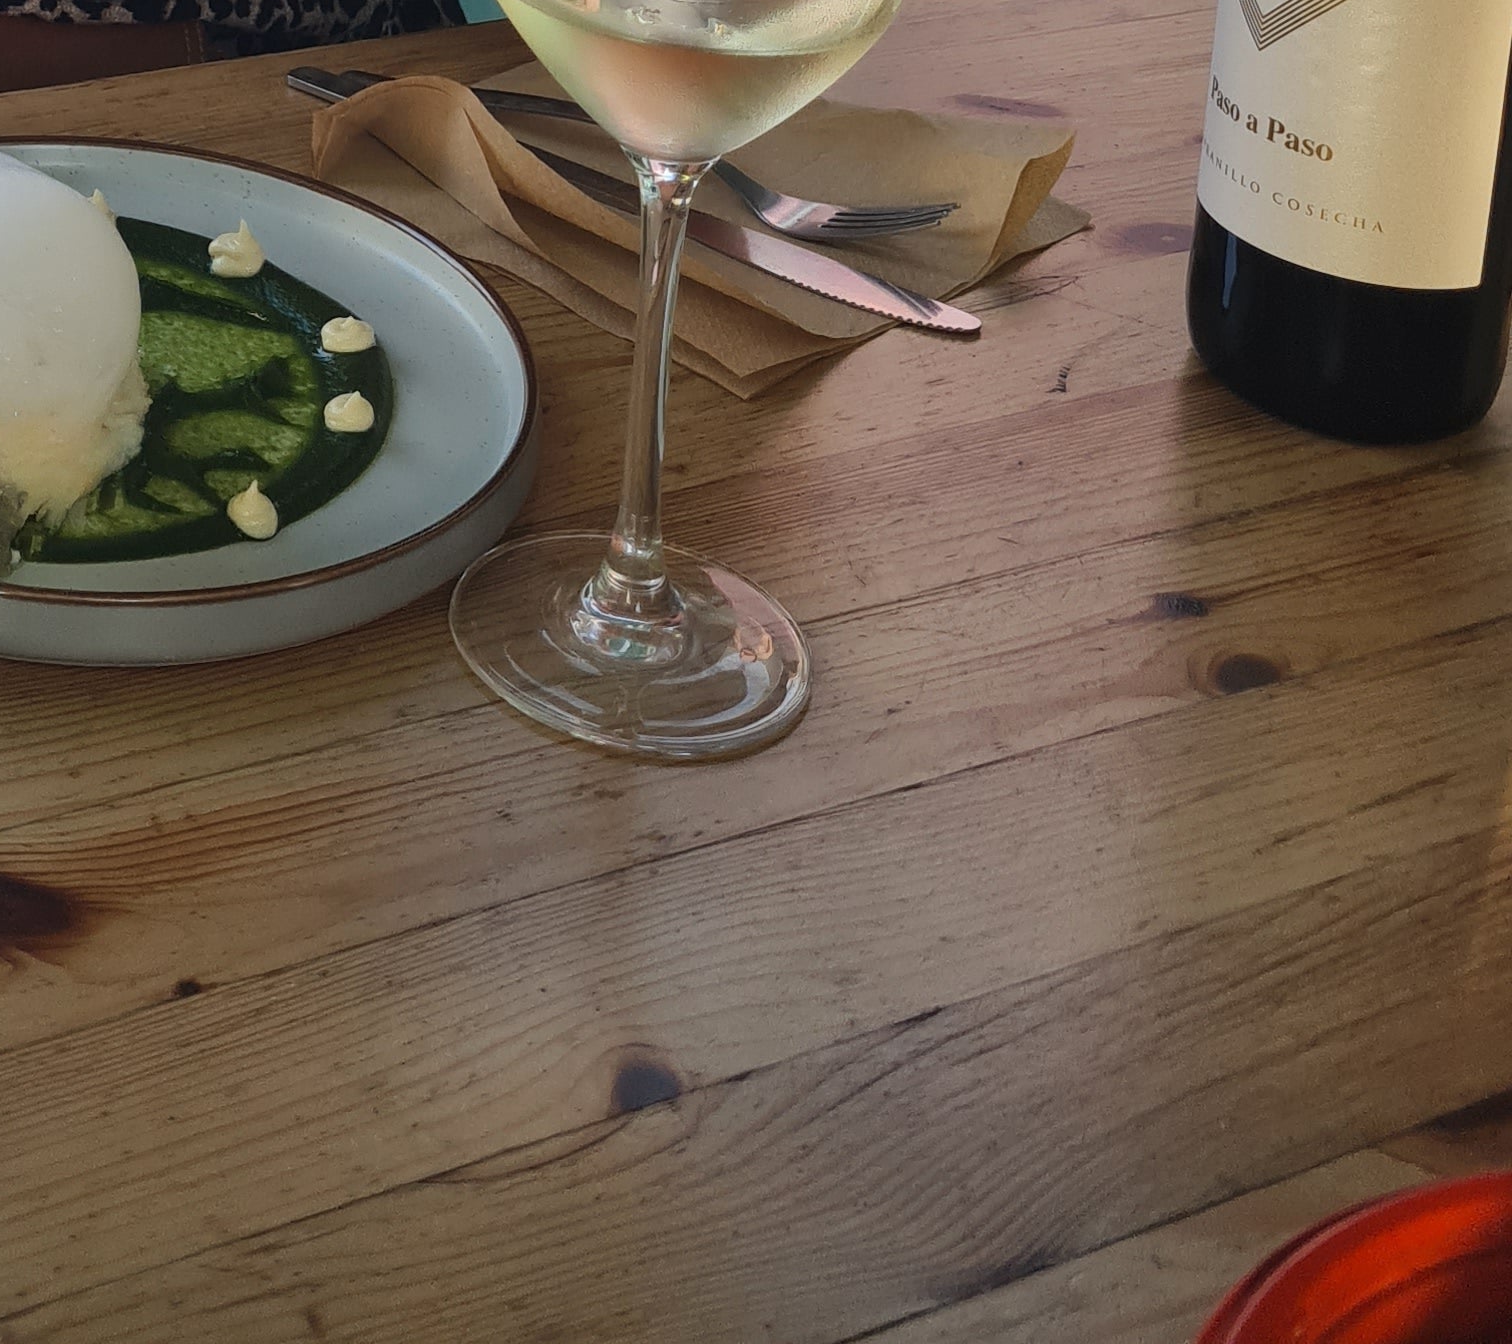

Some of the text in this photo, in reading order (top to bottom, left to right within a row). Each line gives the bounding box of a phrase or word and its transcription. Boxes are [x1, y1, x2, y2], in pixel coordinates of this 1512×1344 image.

[1211, 75, 1334, 162] Paso a Paso
[1272, 193, 1385, 233] COSECHA
